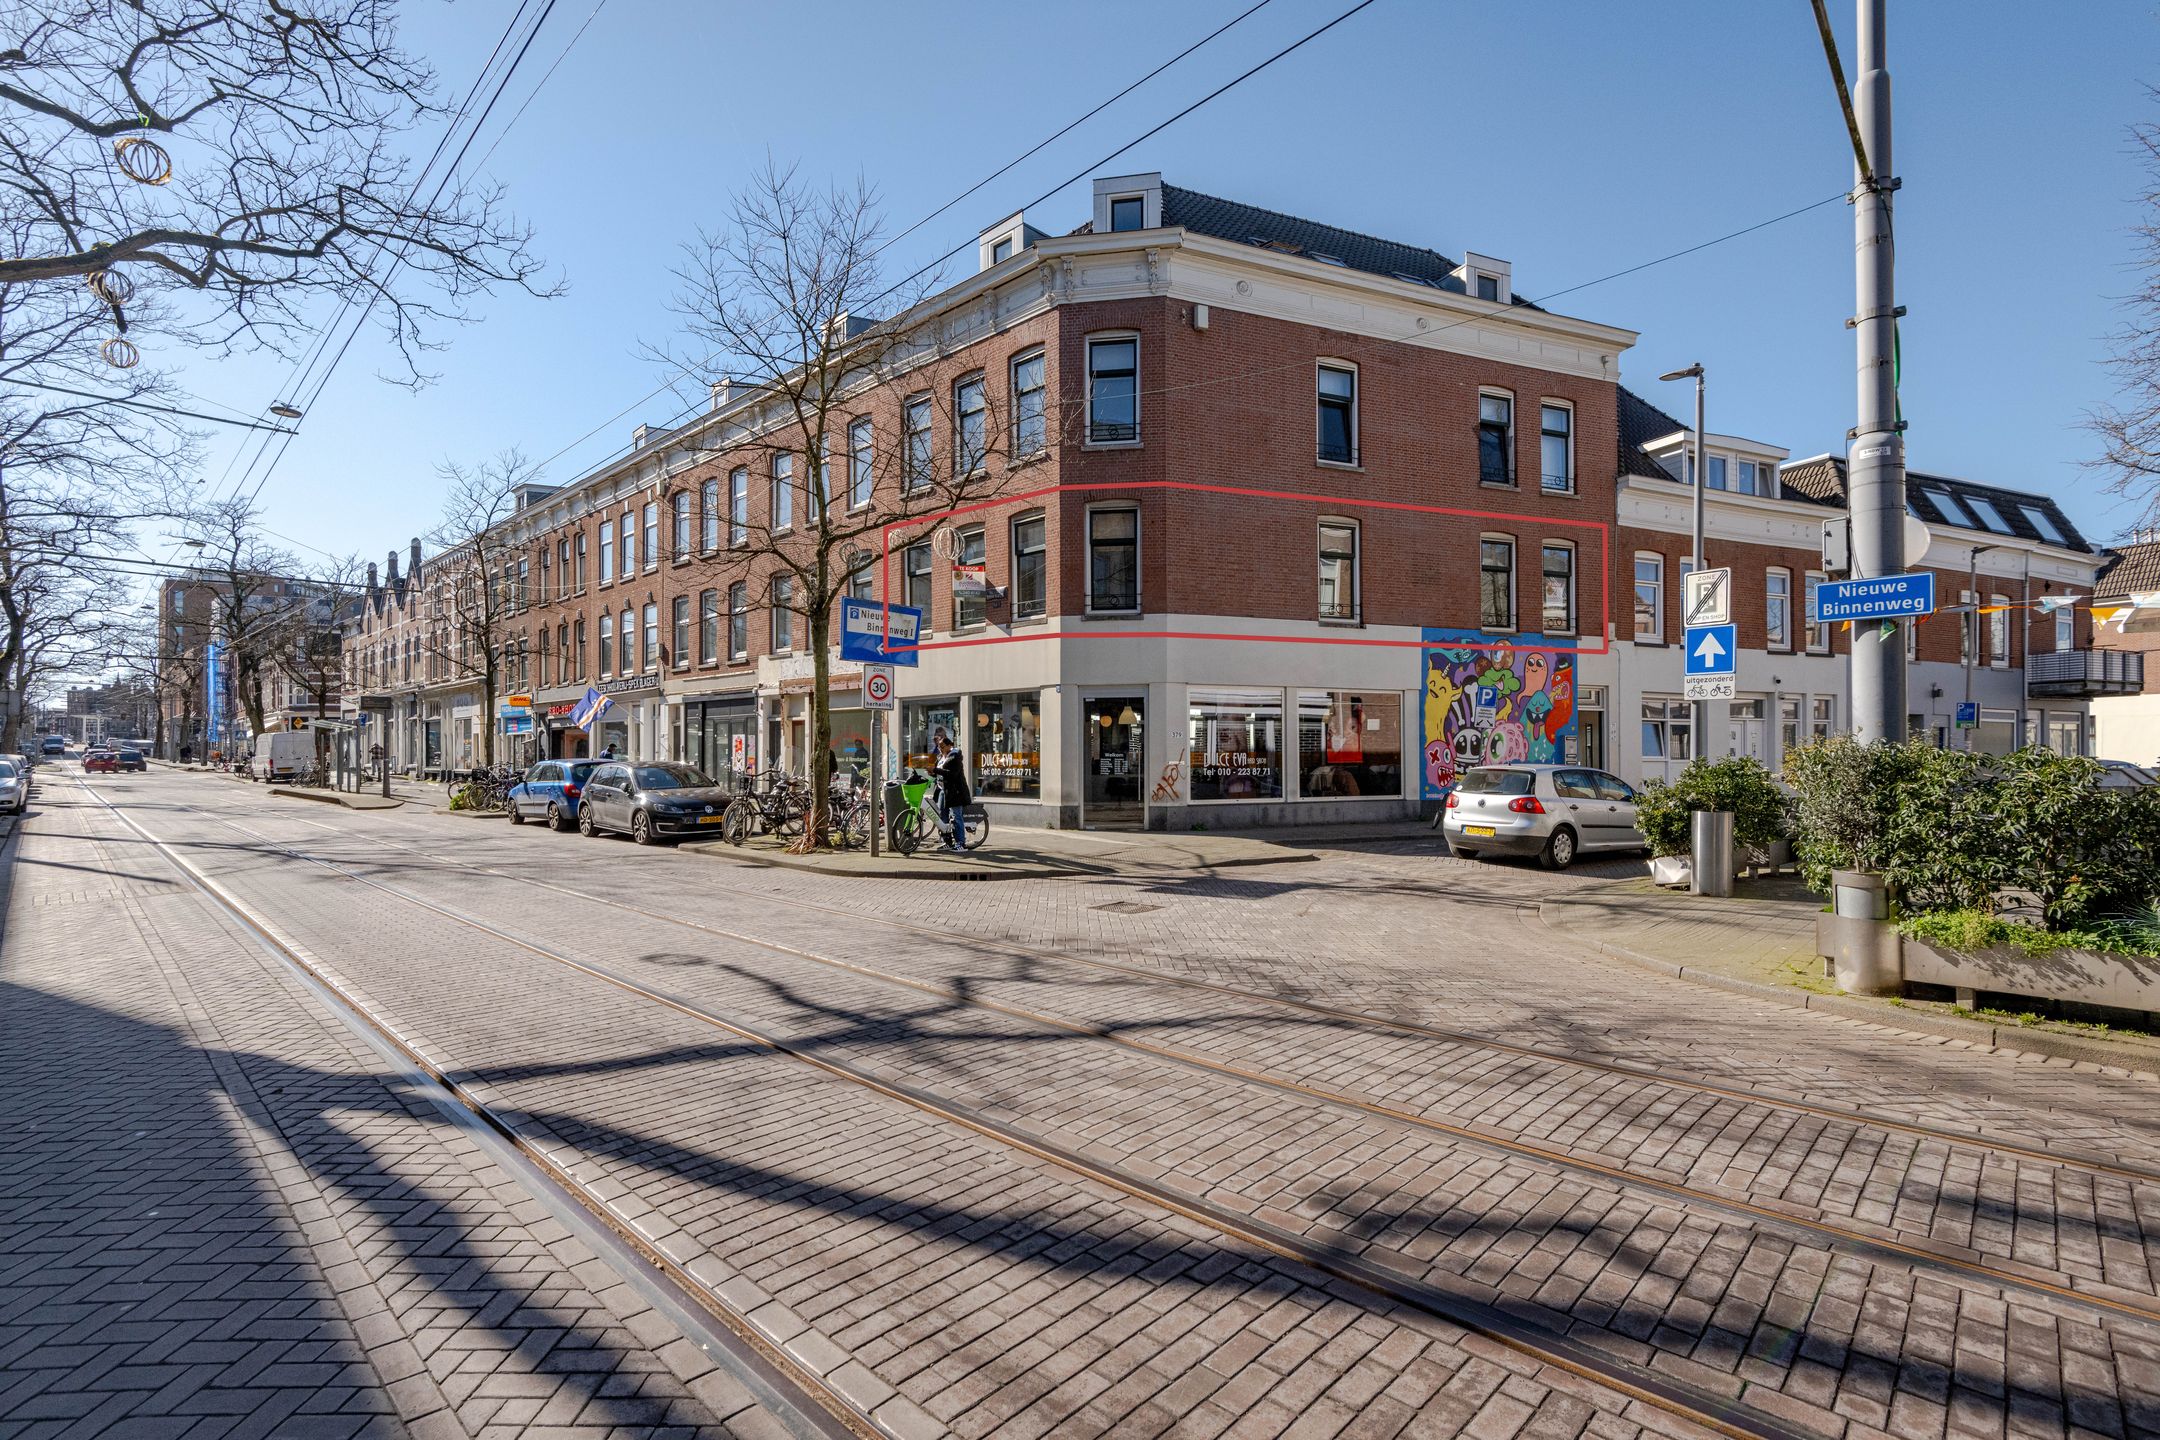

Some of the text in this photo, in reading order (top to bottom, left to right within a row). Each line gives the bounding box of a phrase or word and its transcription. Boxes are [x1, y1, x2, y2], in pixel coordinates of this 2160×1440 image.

[1839, 582, 1908, 598] Nieuwe
[1823, 597, 1925, 616] Binnenweg
[867, 622, 909, 638] Binnnweg
[872, 682, 887, 693] 30
[1686, 675, 1734, 685] uitgezonderd
[1481, 688, 1493, 705] P
[1203, 752, 1230, 768] DULCE
[1232, 752, 1247, 767] EVA
[1005, 768, 1016, 776] 223
[1016, 768, 1023, 776] 87
[1024, 768, 1032, 776] 71
[1217, 767, 1231, 776] 010
[1237, 767, 1251, 776] 223
[1252, 767, 1261, 776] 87
[1262, 767, 1271, 776] 71
